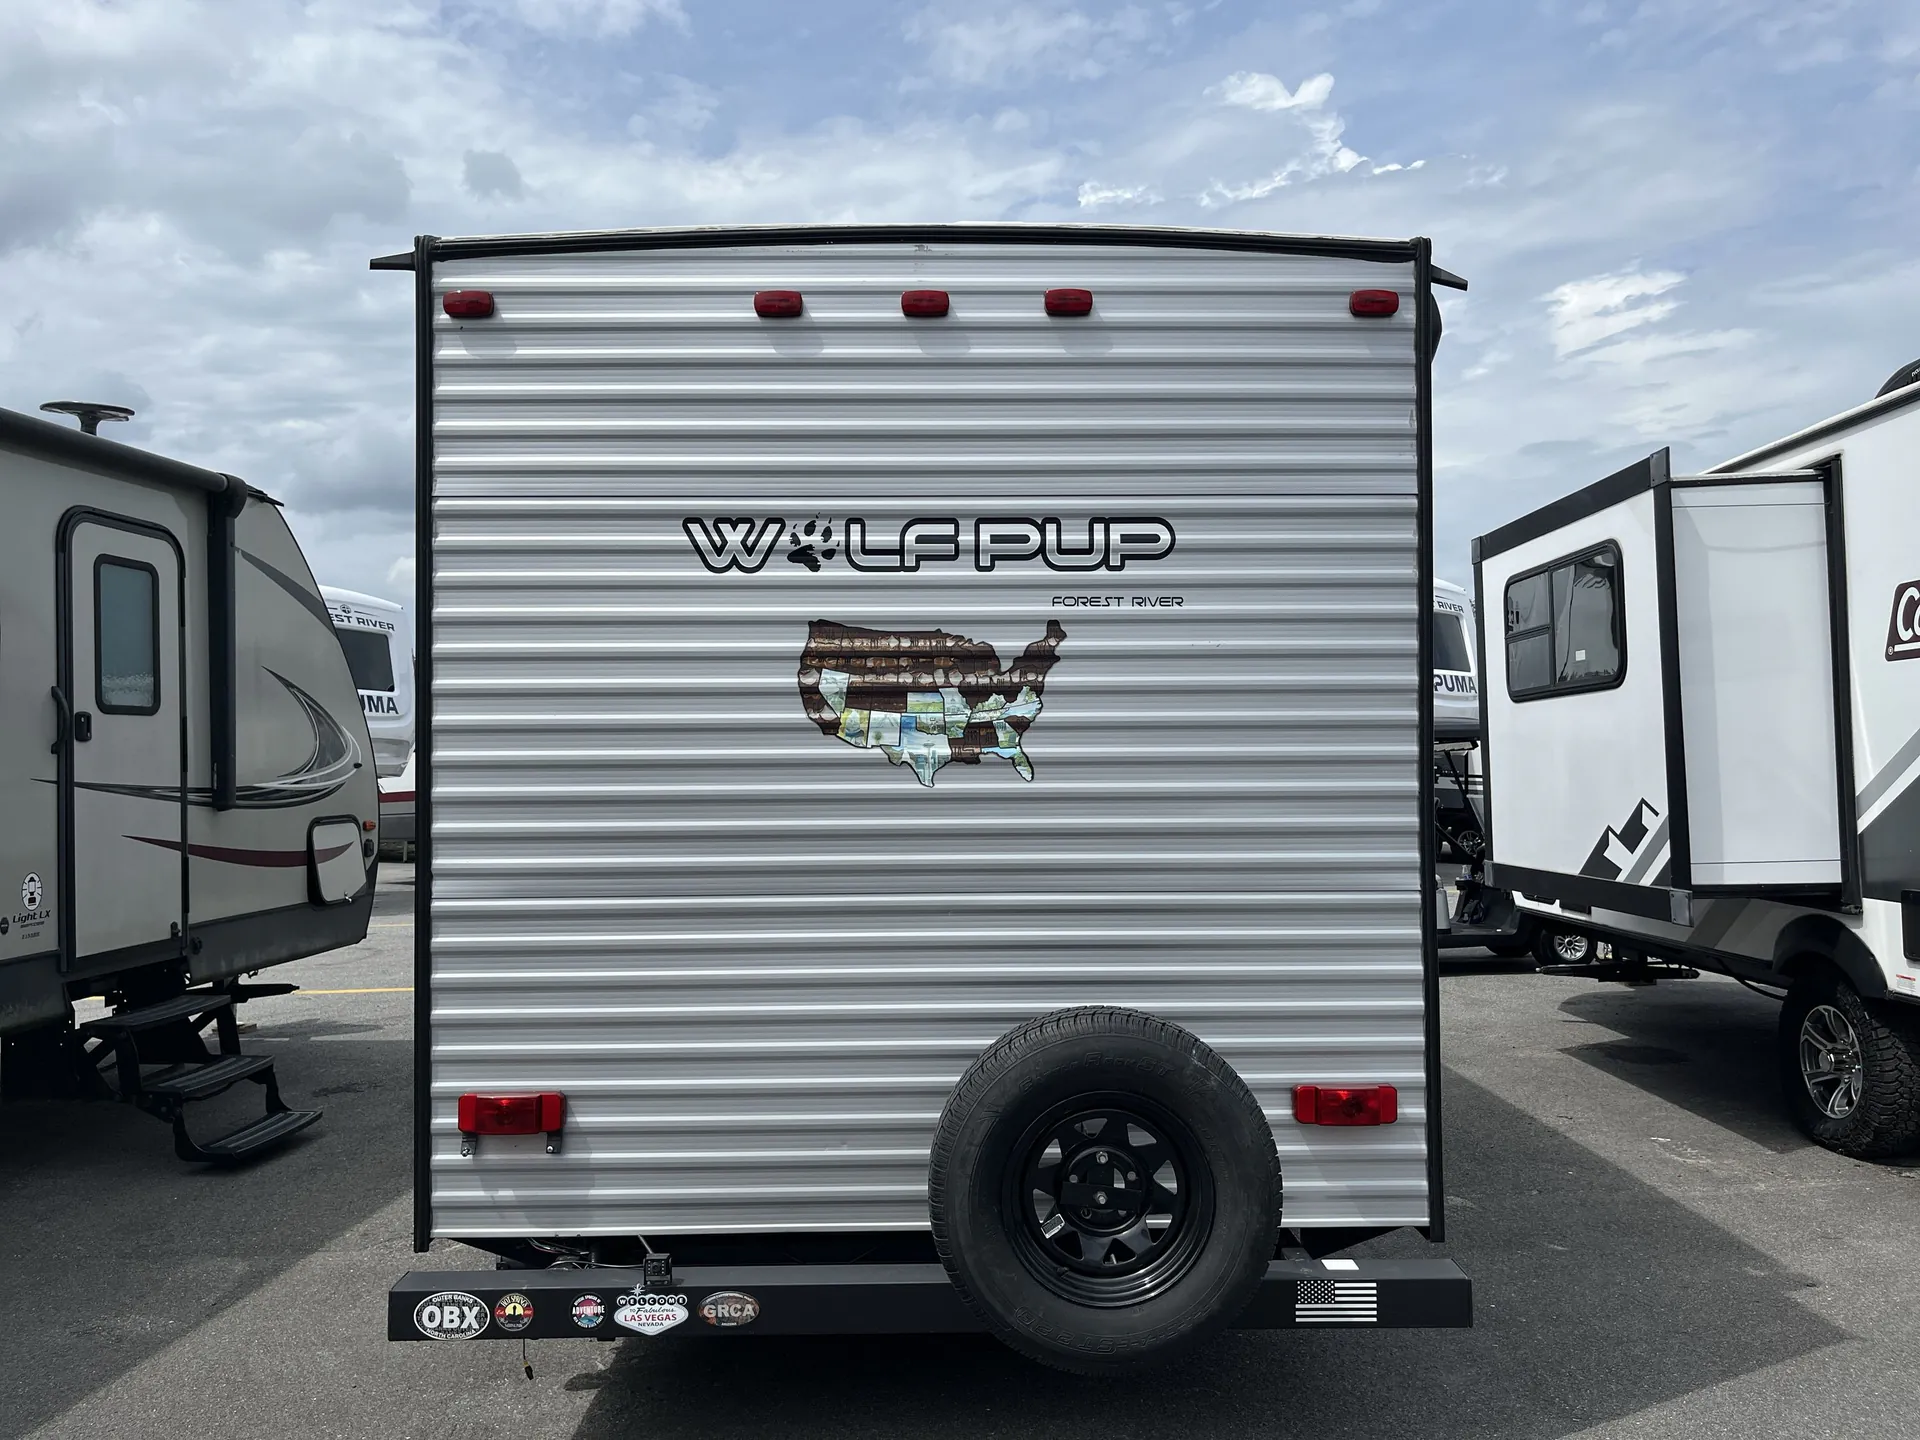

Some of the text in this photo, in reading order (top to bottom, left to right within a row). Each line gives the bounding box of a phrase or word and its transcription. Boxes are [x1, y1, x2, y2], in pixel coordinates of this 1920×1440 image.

[974, 516, 1177, 572] PUP
[1052, 596, 1184, 607] FOREST RIVER
[1437, 601, 1464, 613] RIVER
[356, 616, 395, 631] RIVER
[1434, 674, 1477, 694] PUMA
[12, 909, 51, 924] Light LX
[453, 1294, 474, 1304] BANKS
[619, 1297, 685, 1305] WELCOME
[571, 1305, 606, 1316] ADVENTURE
[636, 1306, 676, 1315] Fabulous
[703, 1303, 756, 1318] GRCA
[422, 1305, 481, 1329] OBX
[624, 1313, 678, 1322] LAS VEGAS
[426, 1328, 477, 1339] NORTH CAROLINA
